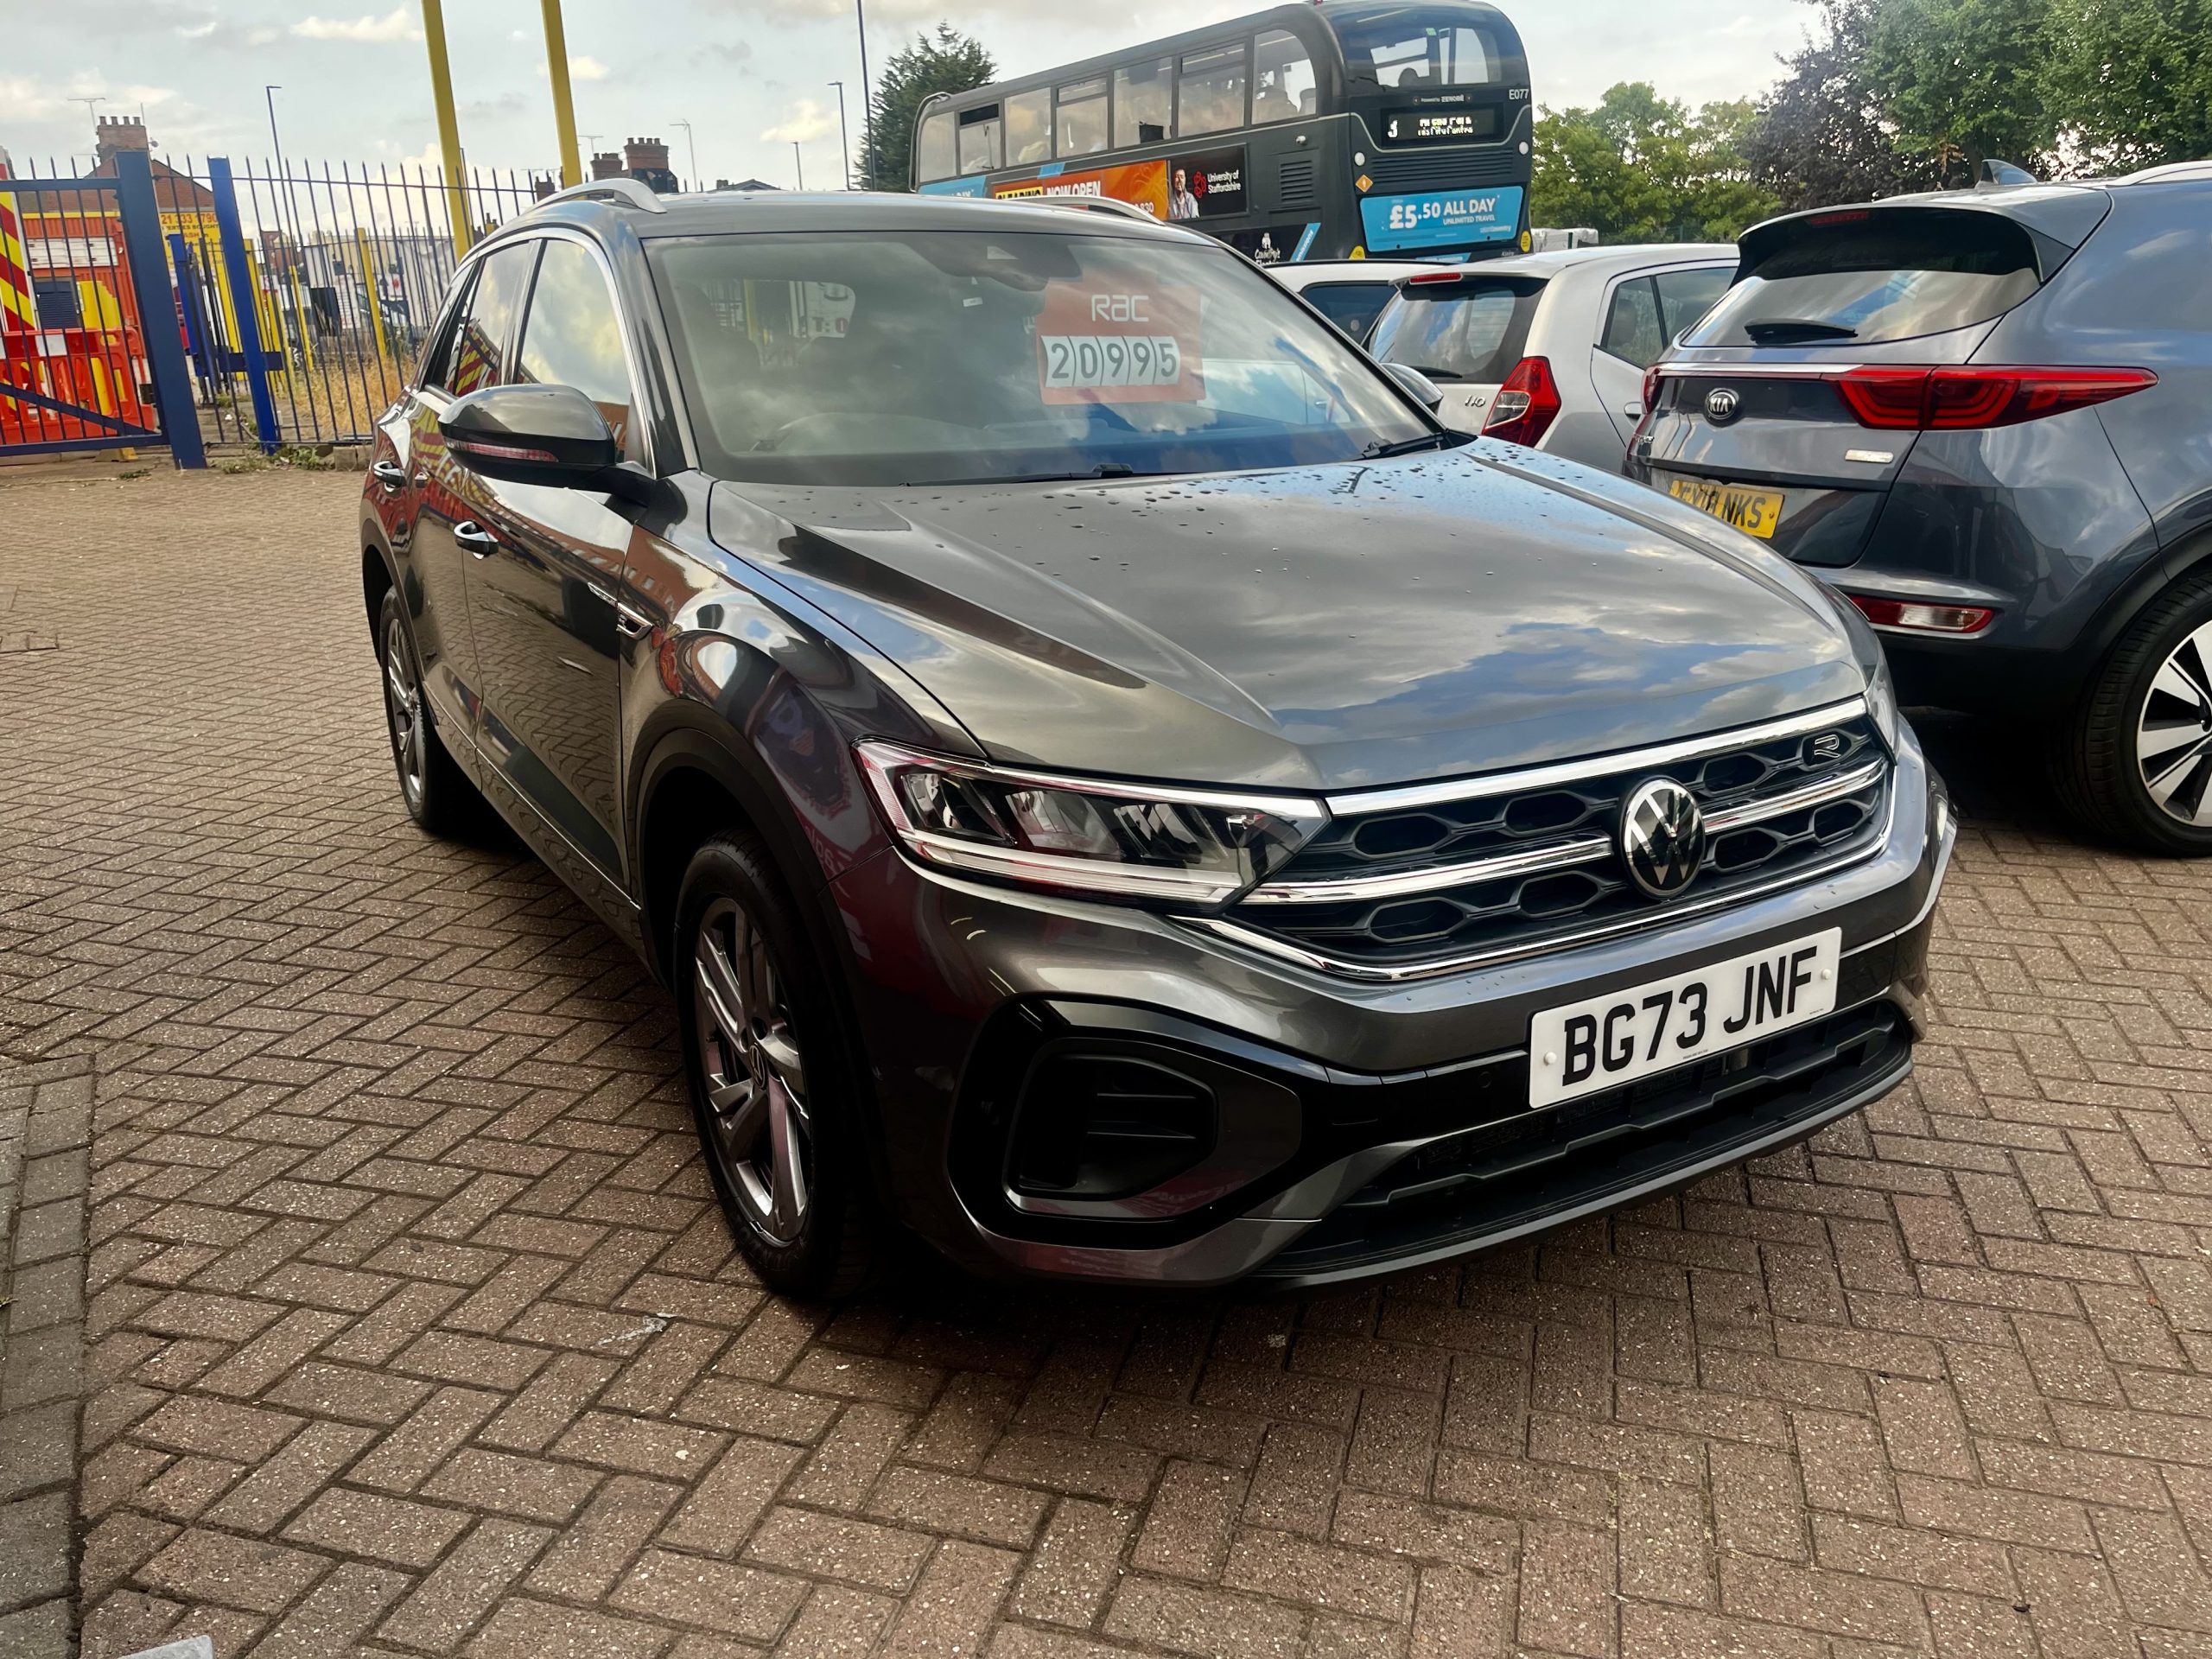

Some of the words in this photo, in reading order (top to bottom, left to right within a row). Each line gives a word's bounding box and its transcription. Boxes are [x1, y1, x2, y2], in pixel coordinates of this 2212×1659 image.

[1509, 89, 1529, 100] E077
[1207, 171, 1232, 183] University
[1232, 168, 1239, 180] of
[1072, 181, 1101, 197] OPEN
[1208, 181, 1242, 194] Staffordshire
[1389, 201, 1441, 229] £5.50
[1443, 200, 1467, 216] ALL
[1469, 198, 1496, 213] DAY
[1442, 215, 1474, 226] UNLIMITED
[1475, 213, 1496, 223] TRAVEL
[1051, 342, 1178, 379] 20995
[1710, 397, 1729, 412] KIA
[1722, 492, 1766, 529] NKS
[1562, 982, 1708, 1087] BG73
[1723, 945, 1817, 1034] JNF
